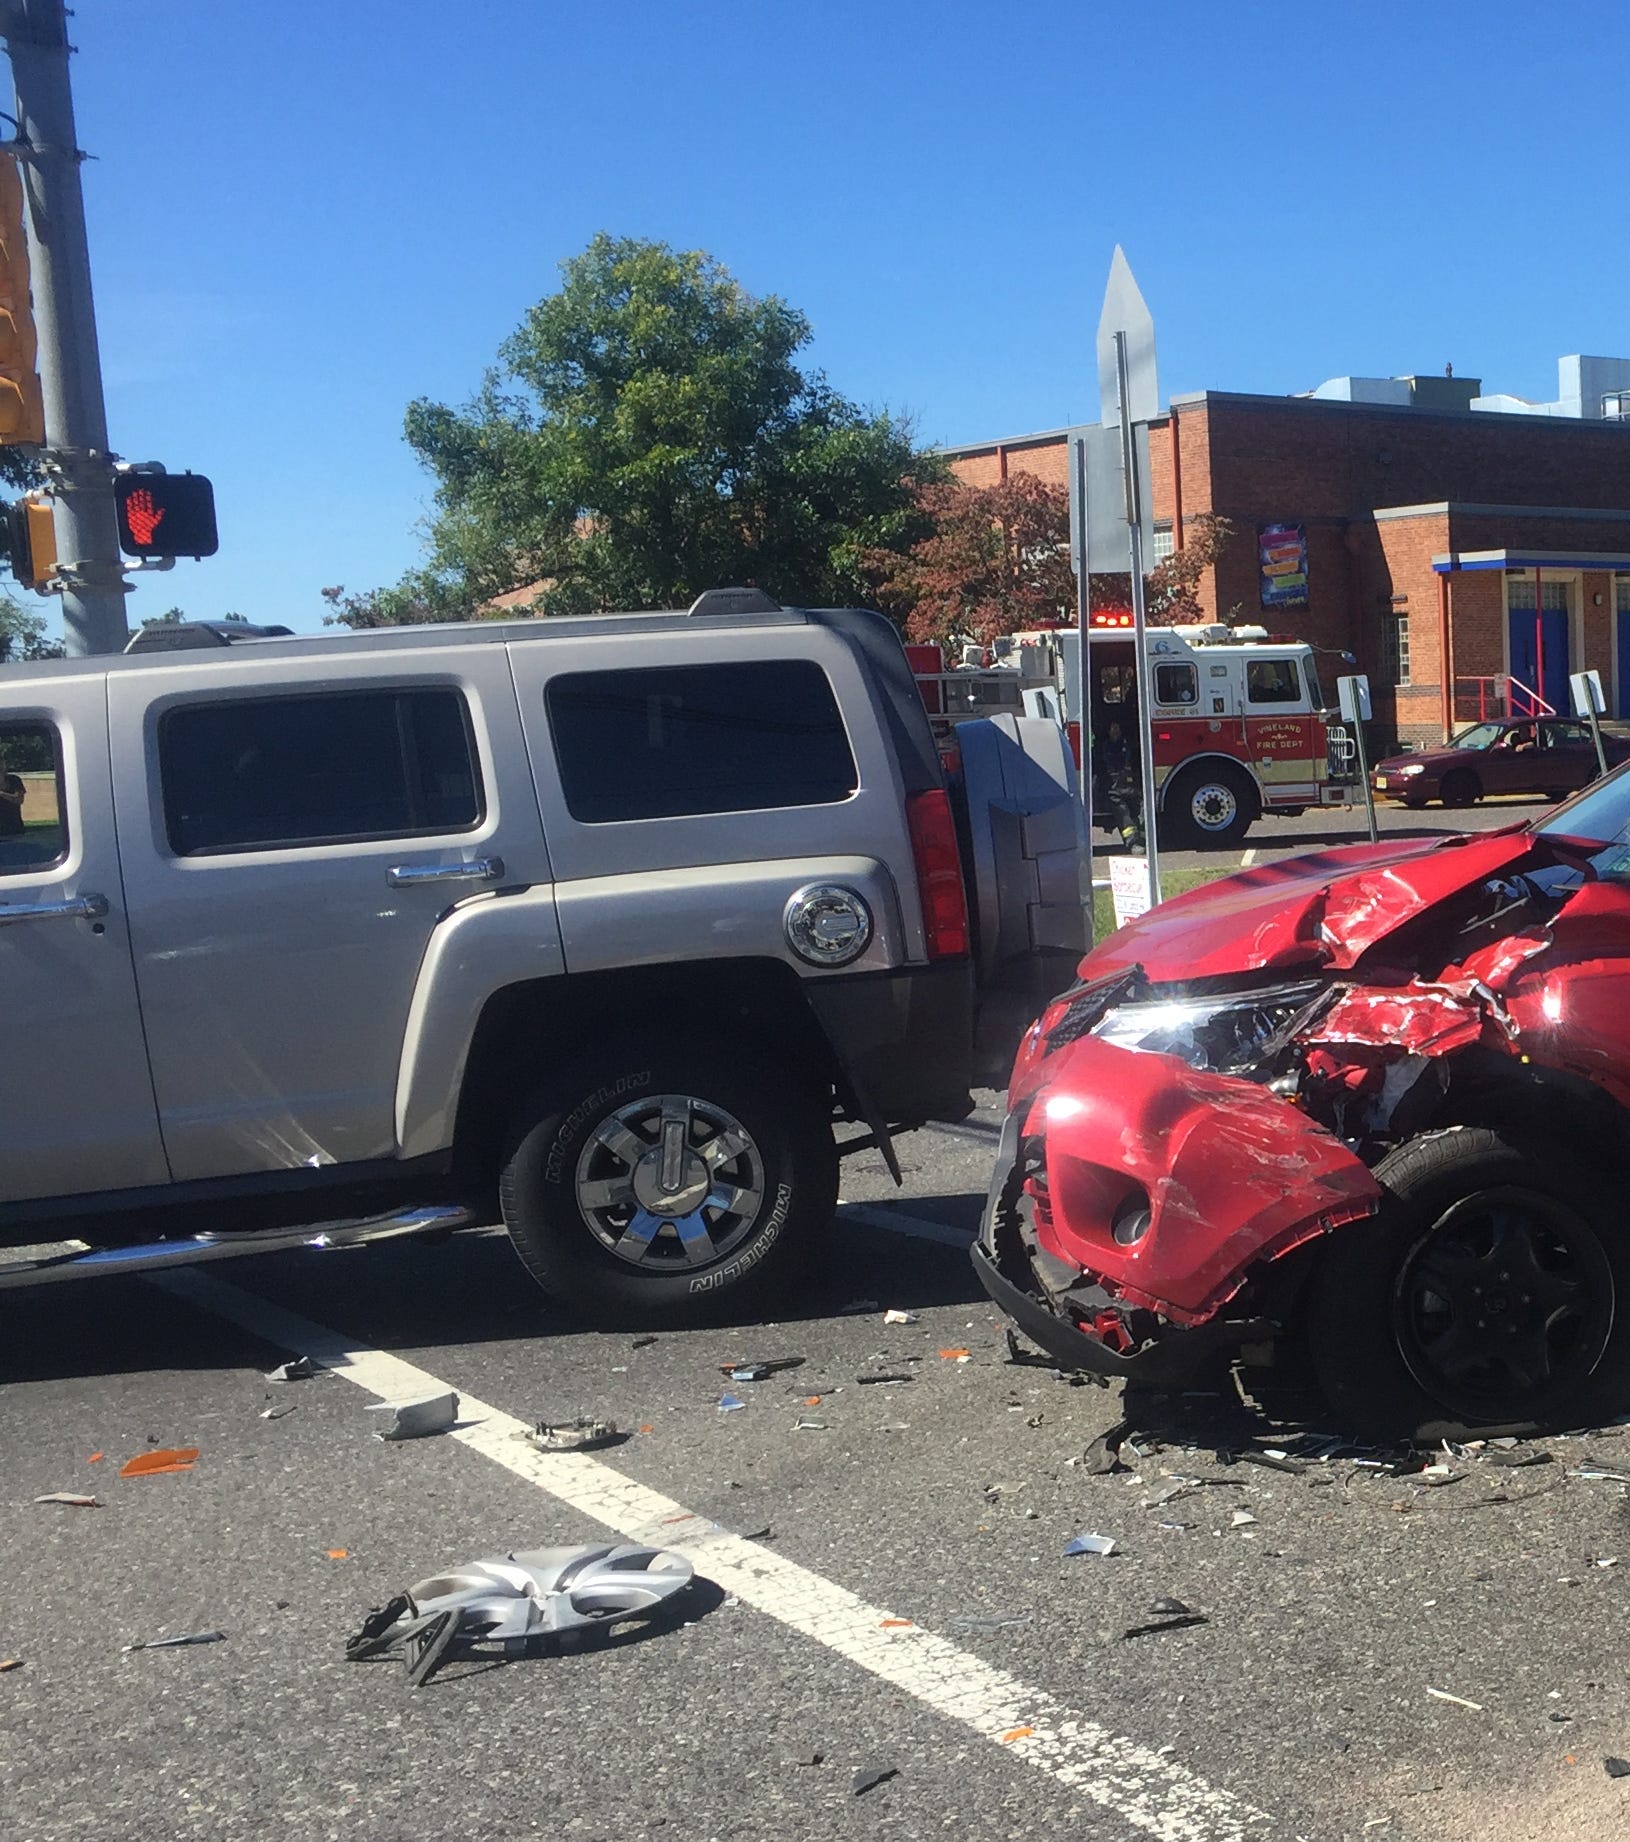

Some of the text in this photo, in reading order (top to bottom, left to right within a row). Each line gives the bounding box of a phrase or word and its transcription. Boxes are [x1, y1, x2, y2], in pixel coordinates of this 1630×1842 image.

[1256, 740, 1304, 750] FIRE DEPT
[1257, 724, 1302, 735] VINELAND
[545, 1071, 652, 1185] MICHELIN
[688, 1182, 793, 1293] MICHELIN
